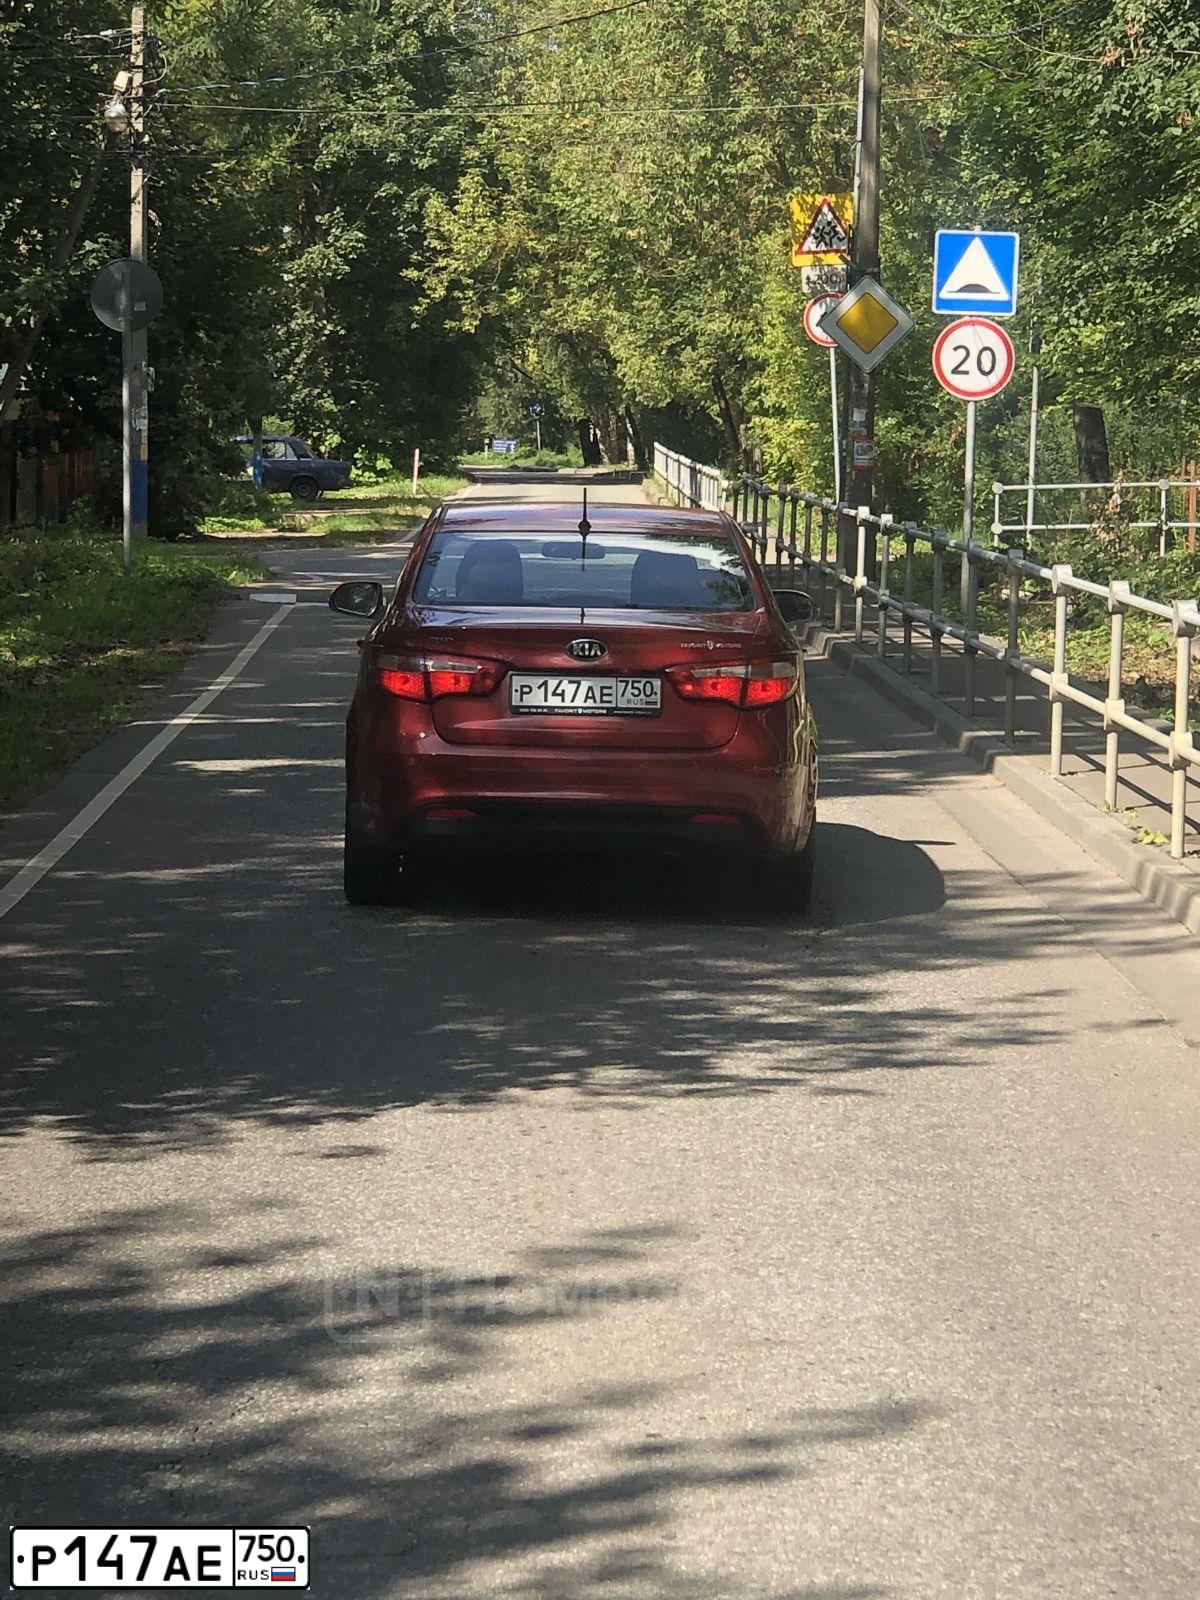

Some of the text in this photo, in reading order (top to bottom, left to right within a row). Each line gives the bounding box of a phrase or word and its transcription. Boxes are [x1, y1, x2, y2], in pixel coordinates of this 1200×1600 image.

[951, 345, 996, 376] 20
[573, 643, 601, 656] KIA
[618, 679, 654, 698] 750
[627, 698, 645, 706] RUS
